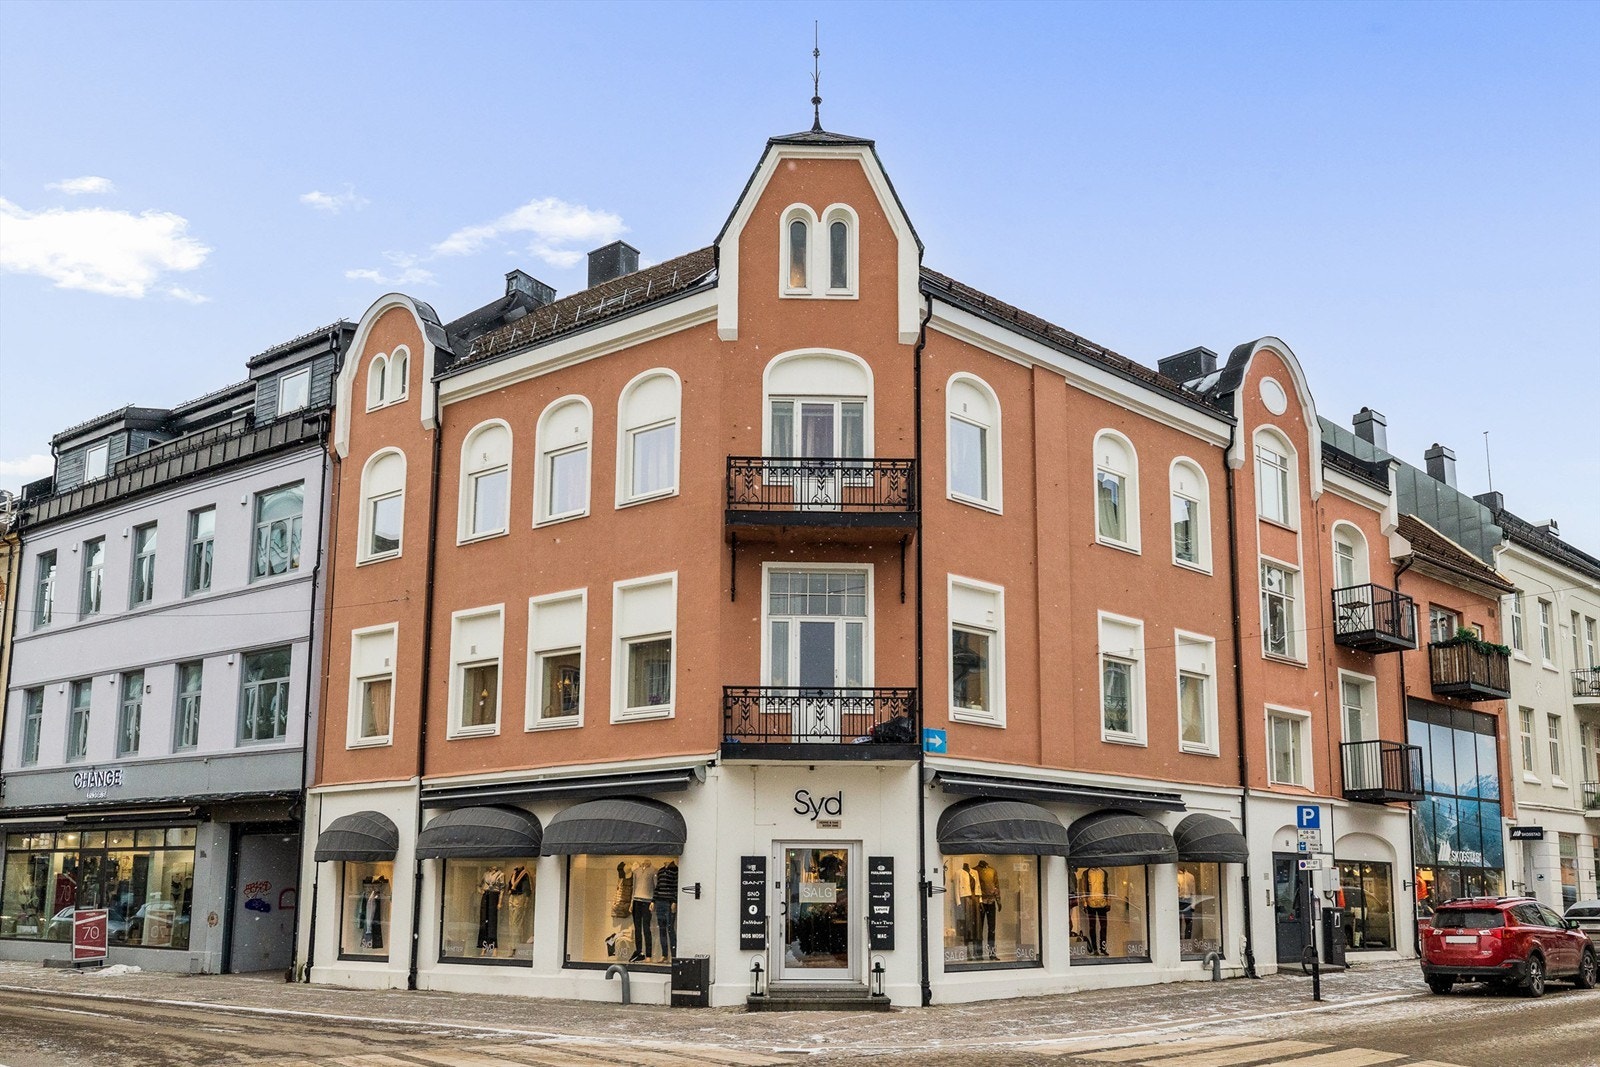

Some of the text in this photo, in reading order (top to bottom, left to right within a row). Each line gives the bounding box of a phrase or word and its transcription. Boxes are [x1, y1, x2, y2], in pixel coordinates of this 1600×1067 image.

[73, 769, 123, 790] CHANGE
[794, 789, 842, 821] Syd
[1302, 808, 1315, 826] P
[803, 886, 832, 898] SALG
[82, 926, 100, 941] 70
[482, 940, 496, 953] Syd
[1016, 947, 1034, 959] SALG
[1127, 944, 1144, 955] SALG
[944, 950, 965, 961] SALG
